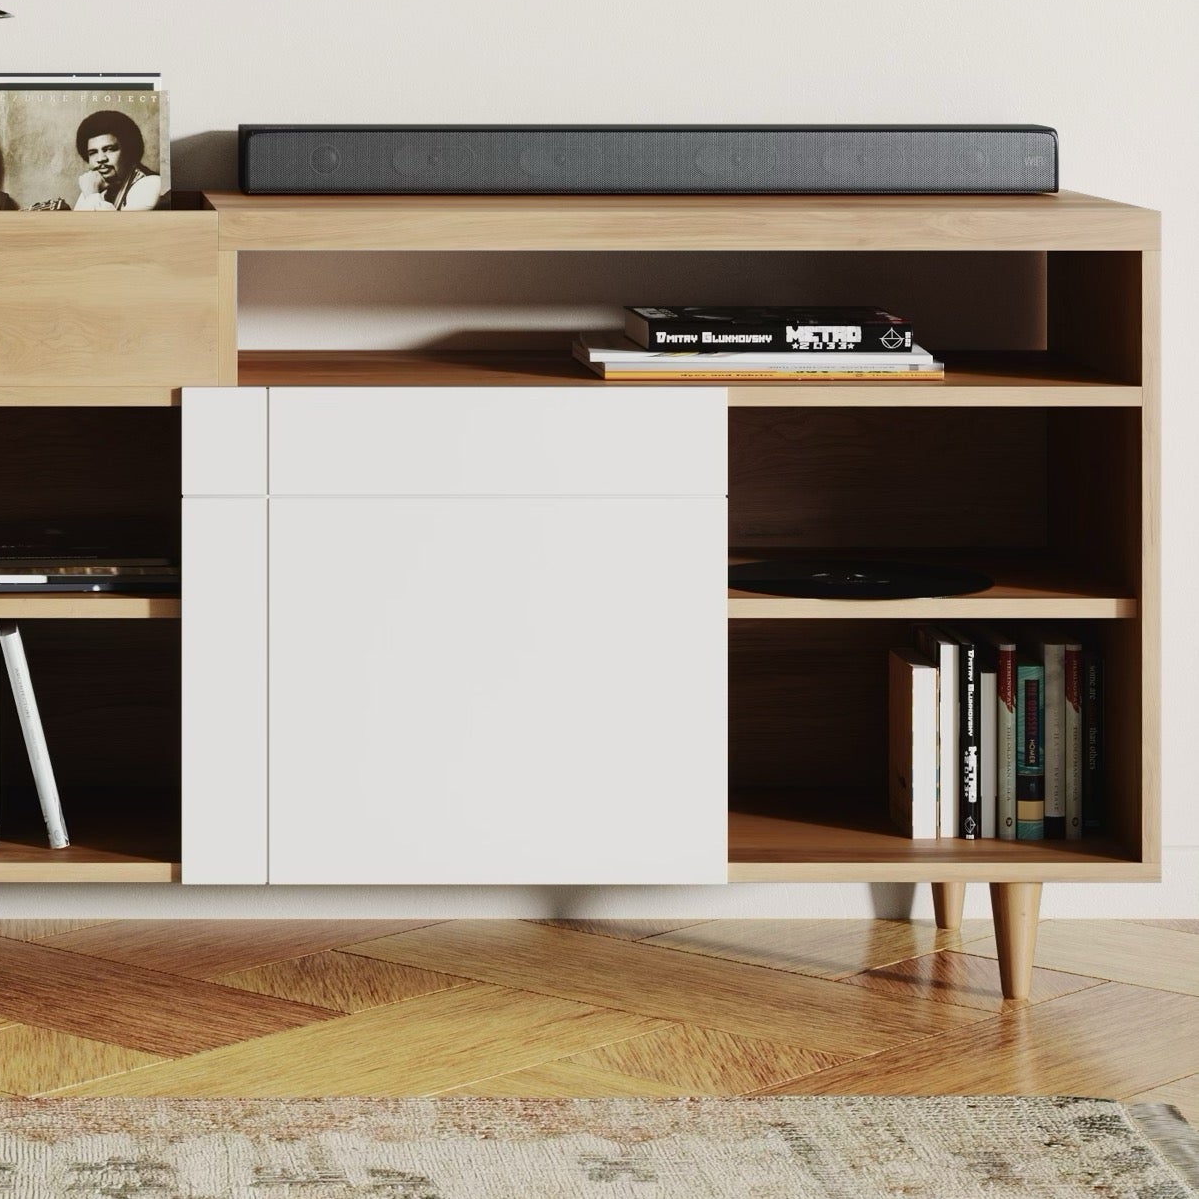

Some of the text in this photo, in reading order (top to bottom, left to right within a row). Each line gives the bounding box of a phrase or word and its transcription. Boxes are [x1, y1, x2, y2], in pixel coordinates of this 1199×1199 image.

[786, 325, 862, 343] METRO
[1026, 699, 1038, 736] ODYSSEY
[1028, 739, 1036, 764] HOMER
